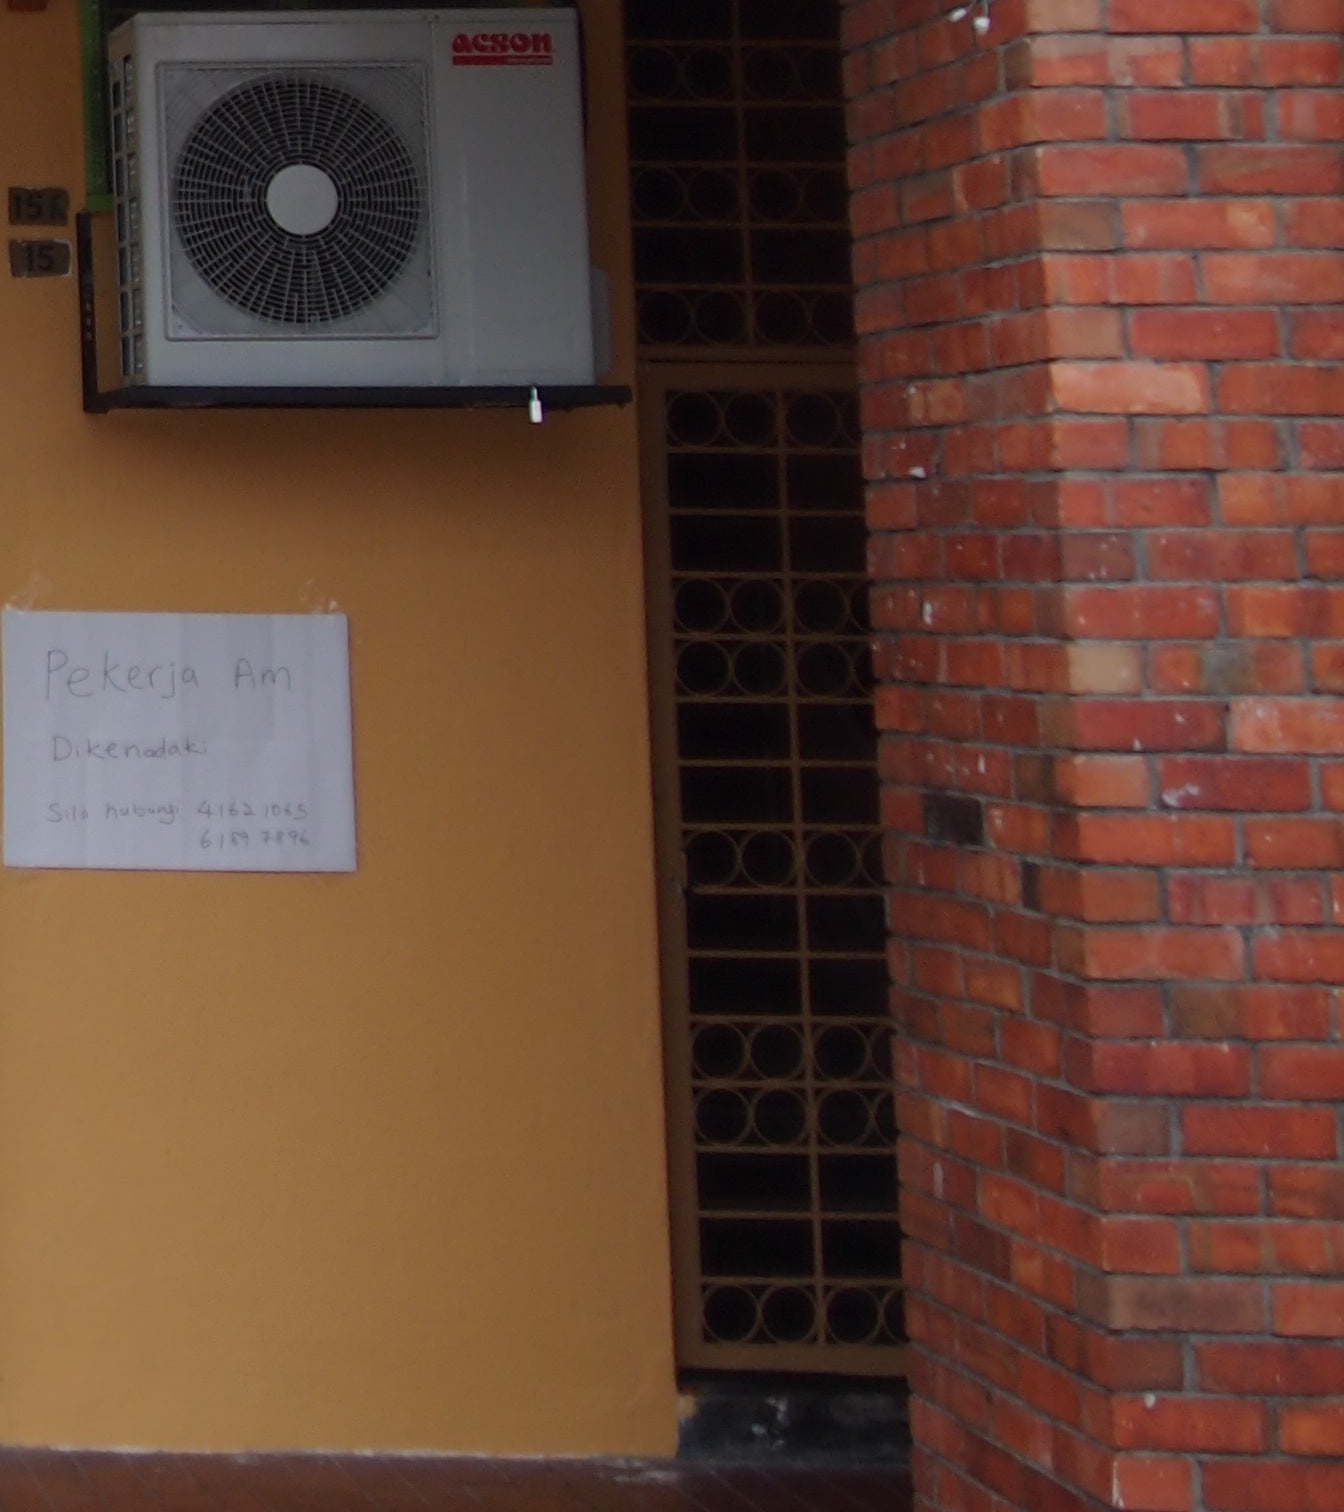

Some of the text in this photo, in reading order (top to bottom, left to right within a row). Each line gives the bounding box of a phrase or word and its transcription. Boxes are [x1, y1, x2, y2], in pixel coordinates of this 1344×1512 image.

[26, 245, 55, 272] 15
[46, 648, 292, 701] Pekerja Am
